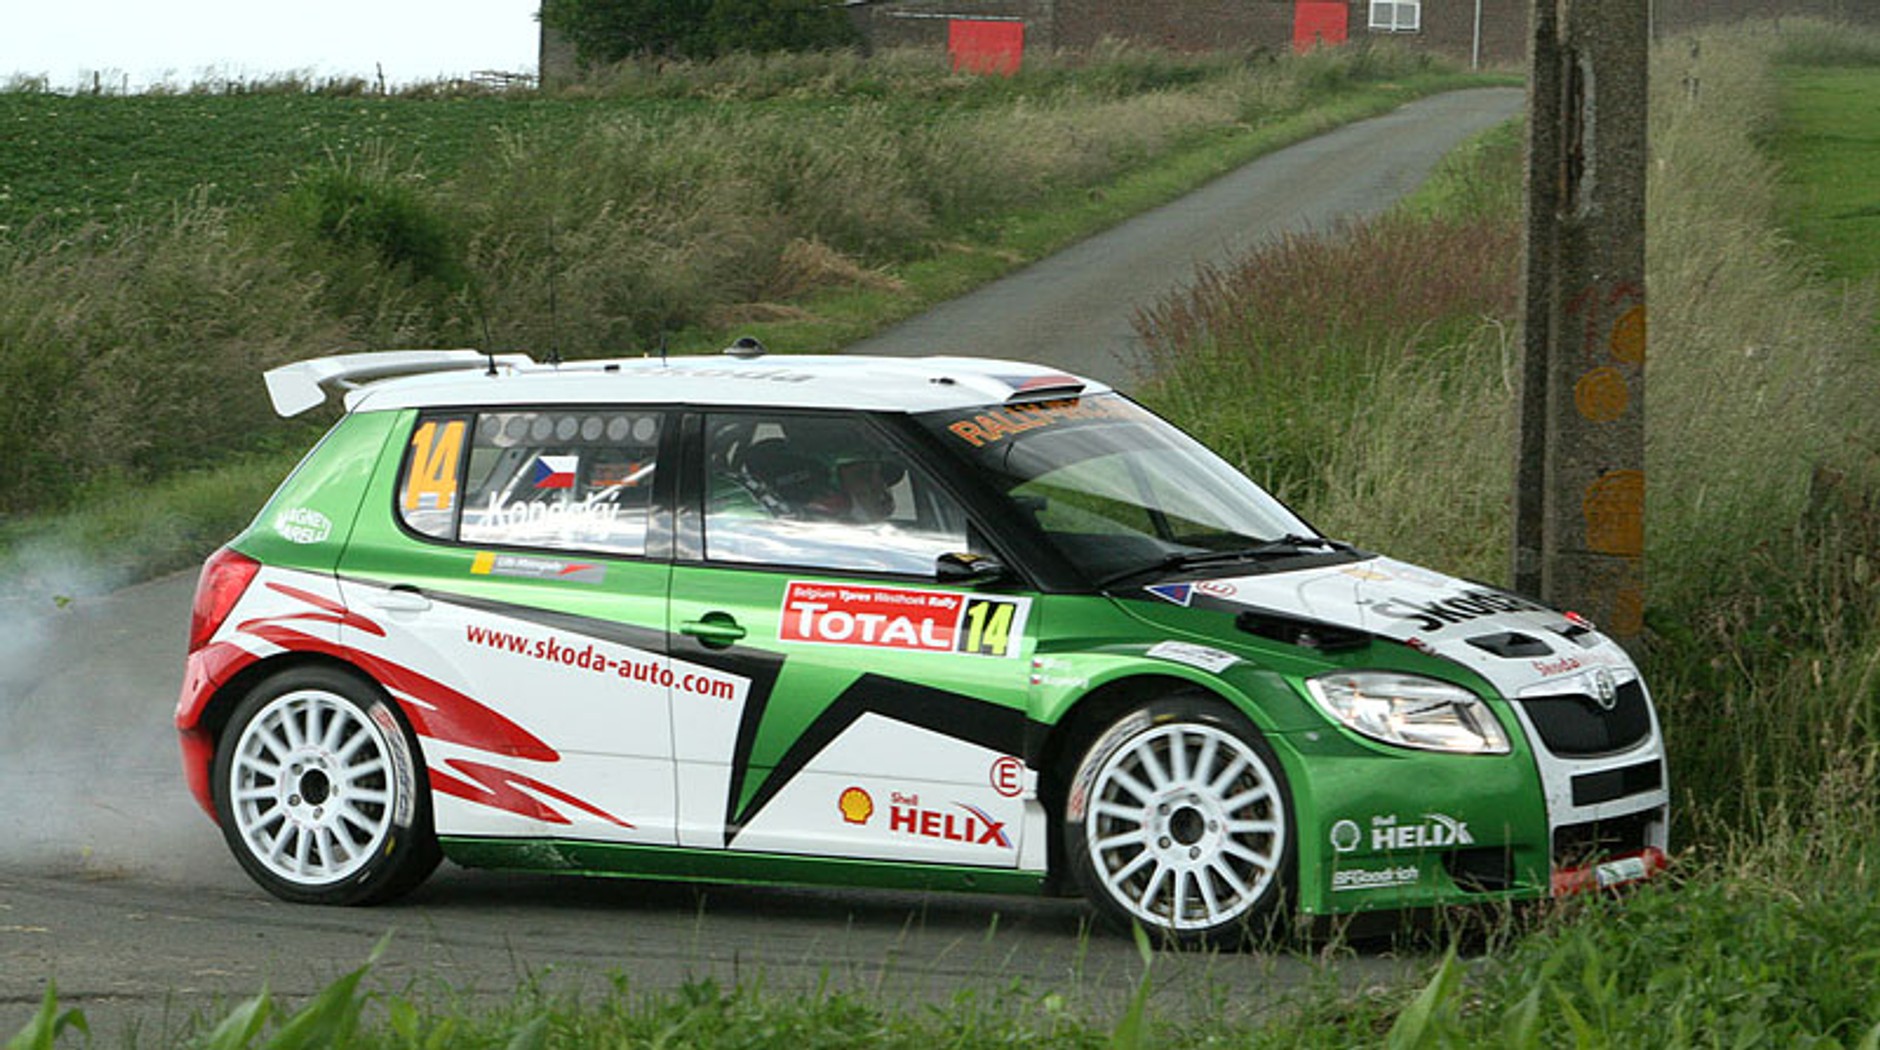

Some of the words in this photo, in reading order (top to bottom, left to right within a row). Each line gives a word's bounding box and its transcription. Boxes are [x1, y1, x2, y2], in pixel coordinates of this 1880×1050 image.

[406, 420, 466, 510] 14
[793, 587, 836, 600] Belgium
[839, 590, 871, 602] Ypres
[928, 596, 958, 610] Rally
[790, 601, 951, 648] TOTAL
[967, 600, 1015, 656] 14
[466, 624, 735, 700] www.skoda-auto.com
[999, 763, 1017, 789] E
[889, 804, 1013, 849] HELIX
[1371, 815, 1475, 850] HELIX
[1333, 866, 1419, 886] BFGoodich
